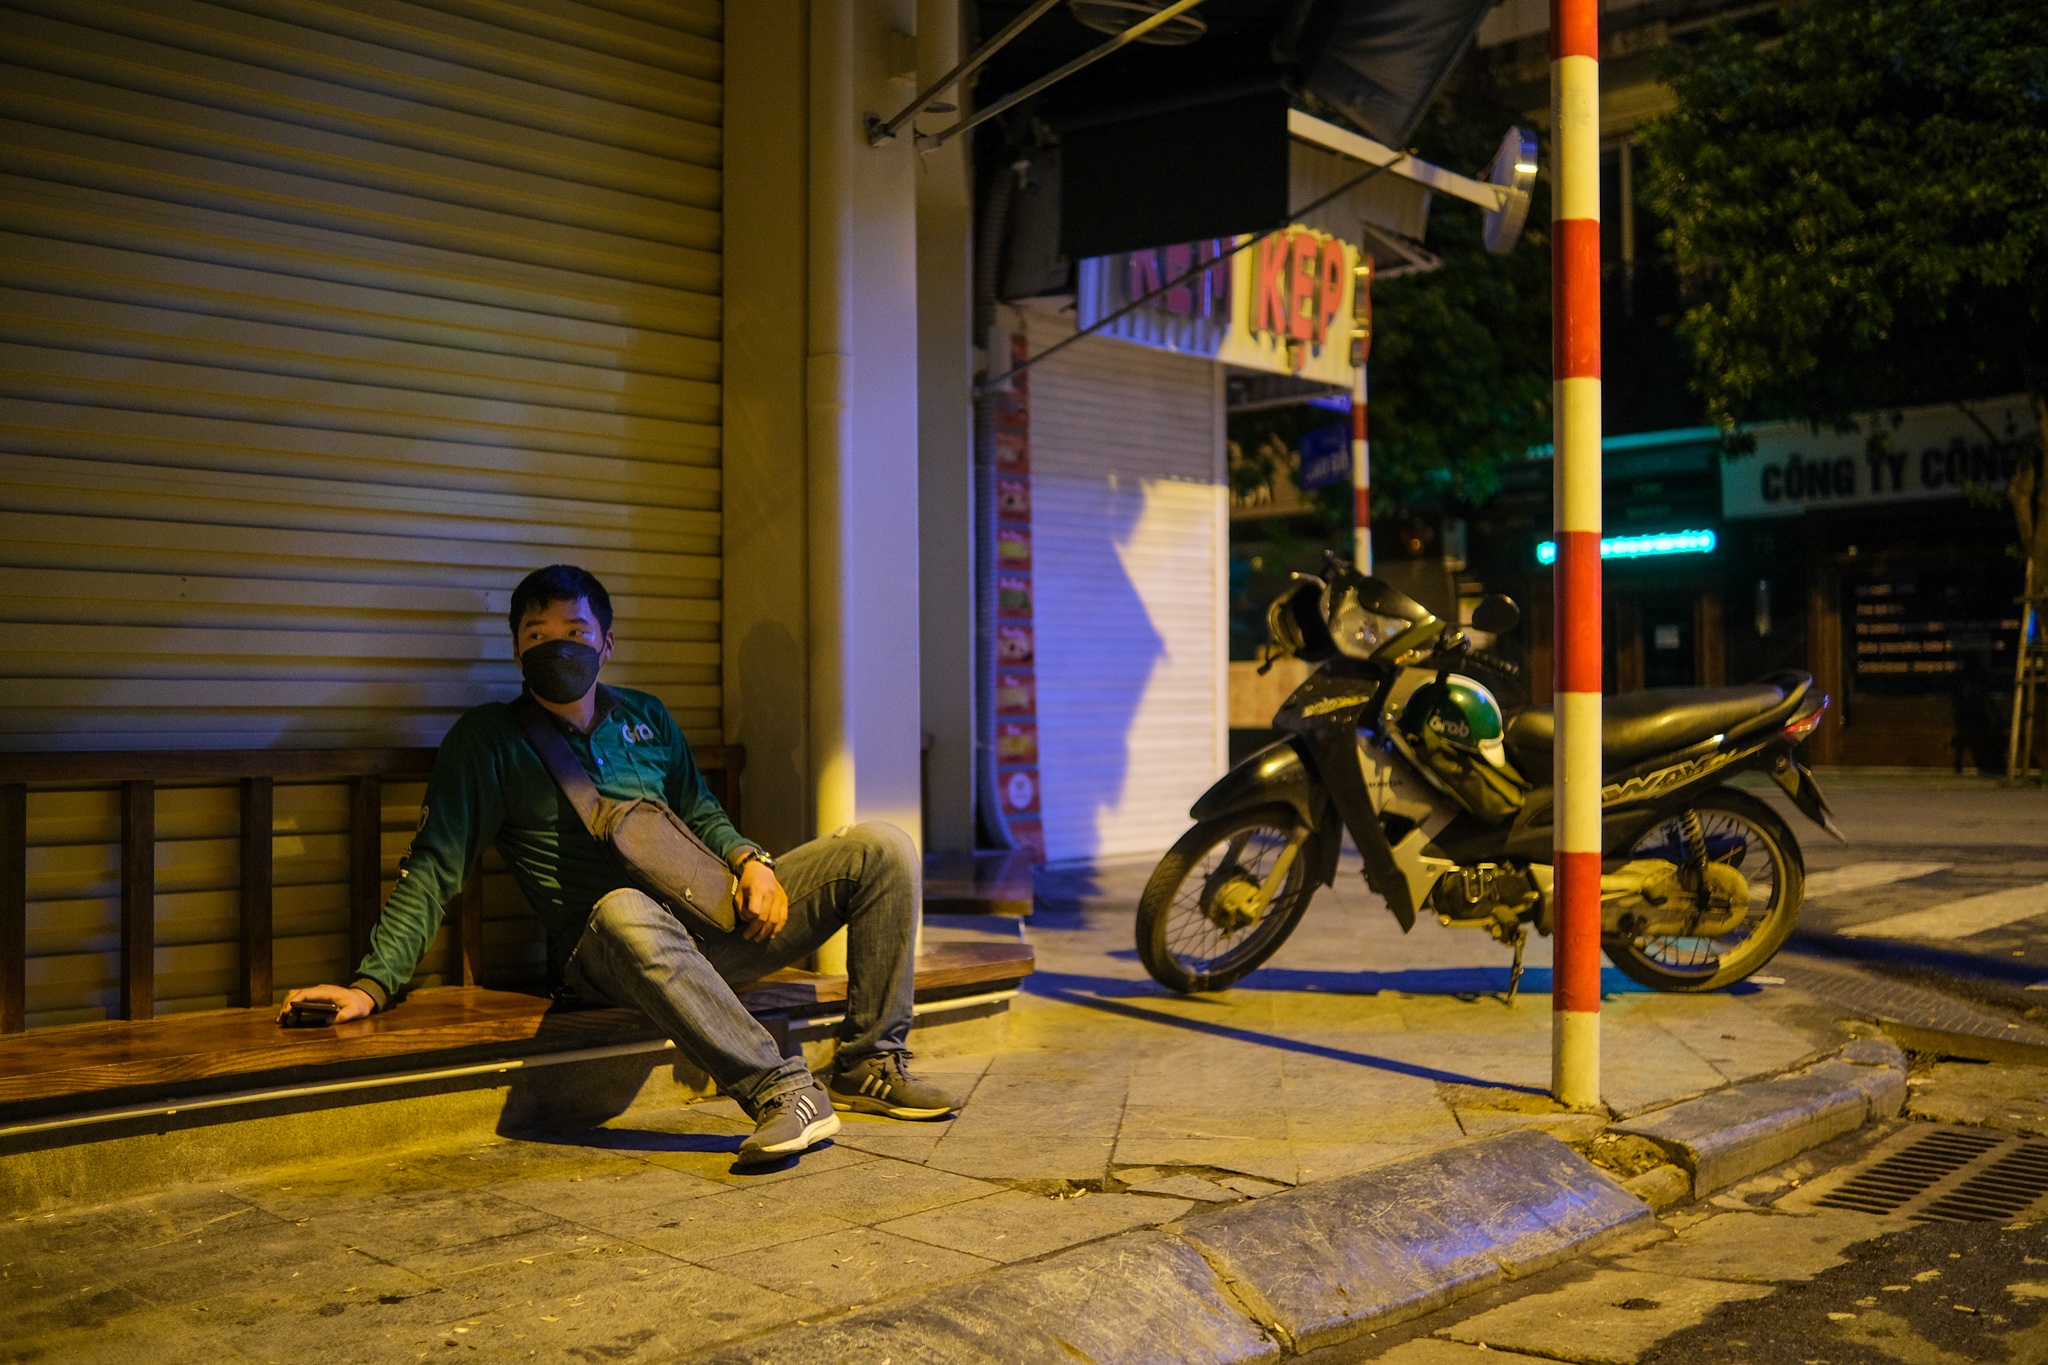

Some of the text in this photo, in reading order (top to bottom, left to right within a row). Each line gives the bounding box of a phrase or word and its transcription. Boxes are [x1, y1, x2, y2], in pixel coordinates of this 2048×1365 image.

[1761, 452, 1855, 504] CÔNG
[1869, 453, 1907, 493] TY
[1429, 714, 1471, 739] Grab
